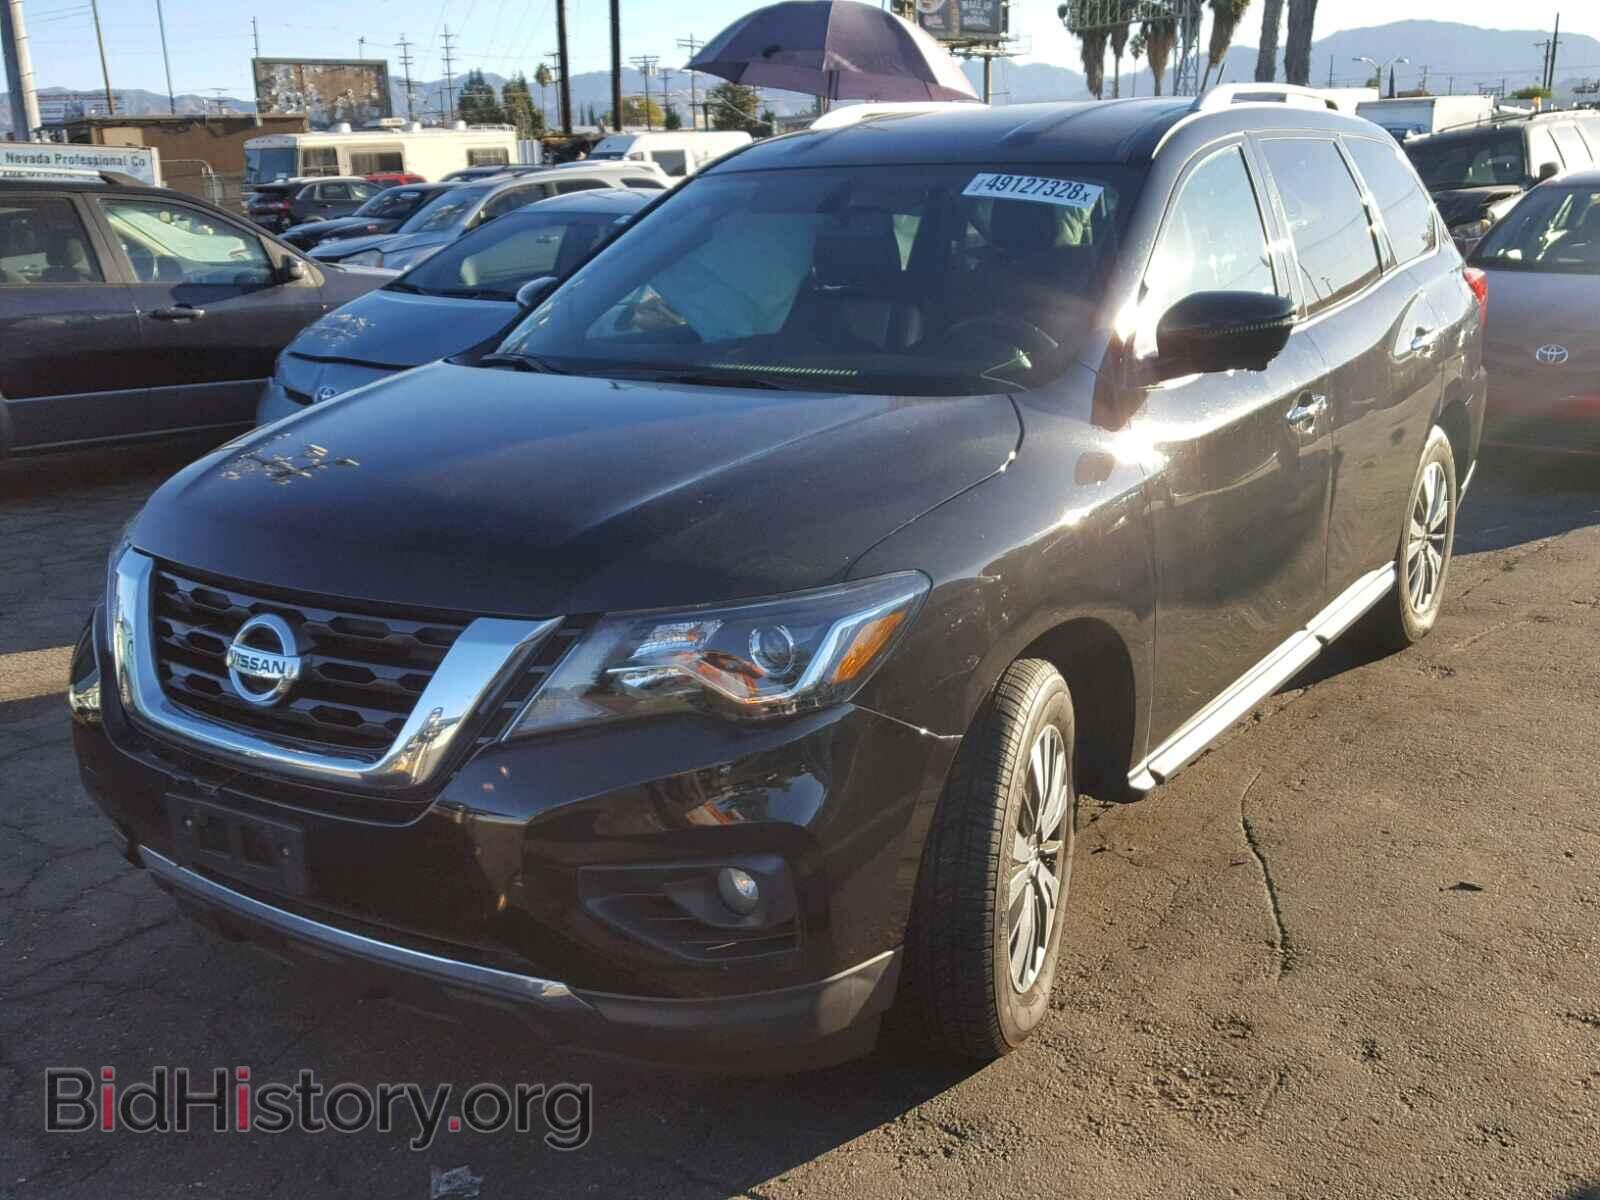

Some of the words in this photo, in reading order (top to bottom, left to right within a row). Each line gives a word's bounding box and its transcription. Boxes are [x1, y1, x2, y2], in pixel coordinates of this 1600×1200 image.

[5, 152, 51, 166] Nevada
[54, 153, 127, 168] Professional
[130, 155, 146, 168] Co
[229, 649, 287, 674] NISSAN
